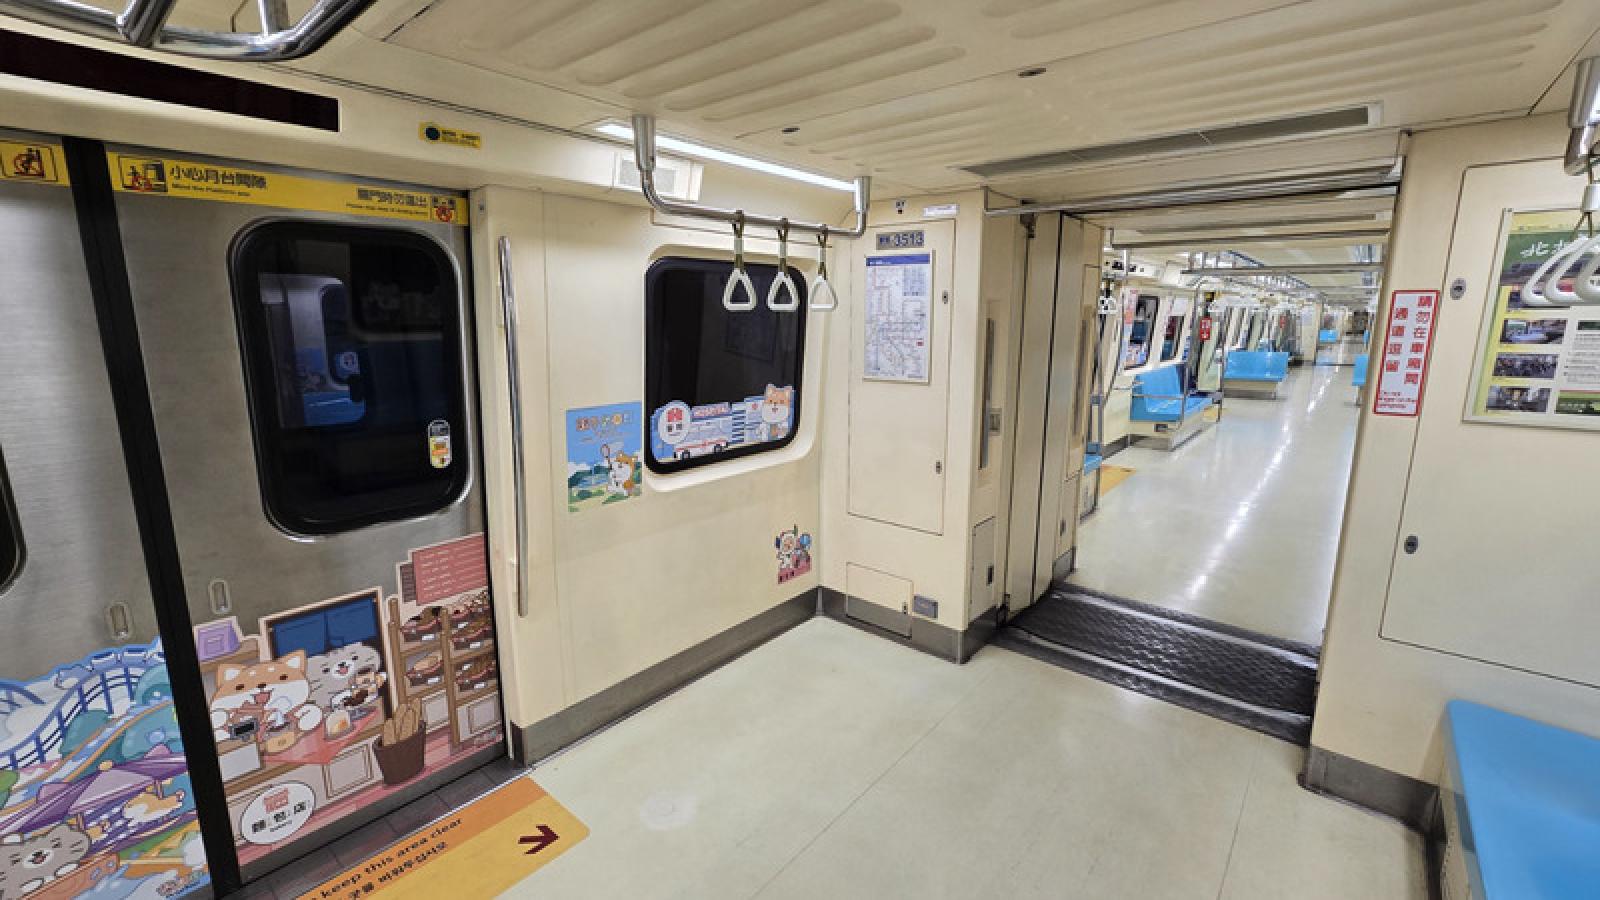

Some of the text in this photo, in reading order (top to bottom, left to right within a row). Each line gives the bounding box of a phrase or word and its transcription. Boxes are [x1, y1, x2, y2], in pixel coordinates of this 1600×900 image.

[320, 818, 462, 898] keep this area clear
